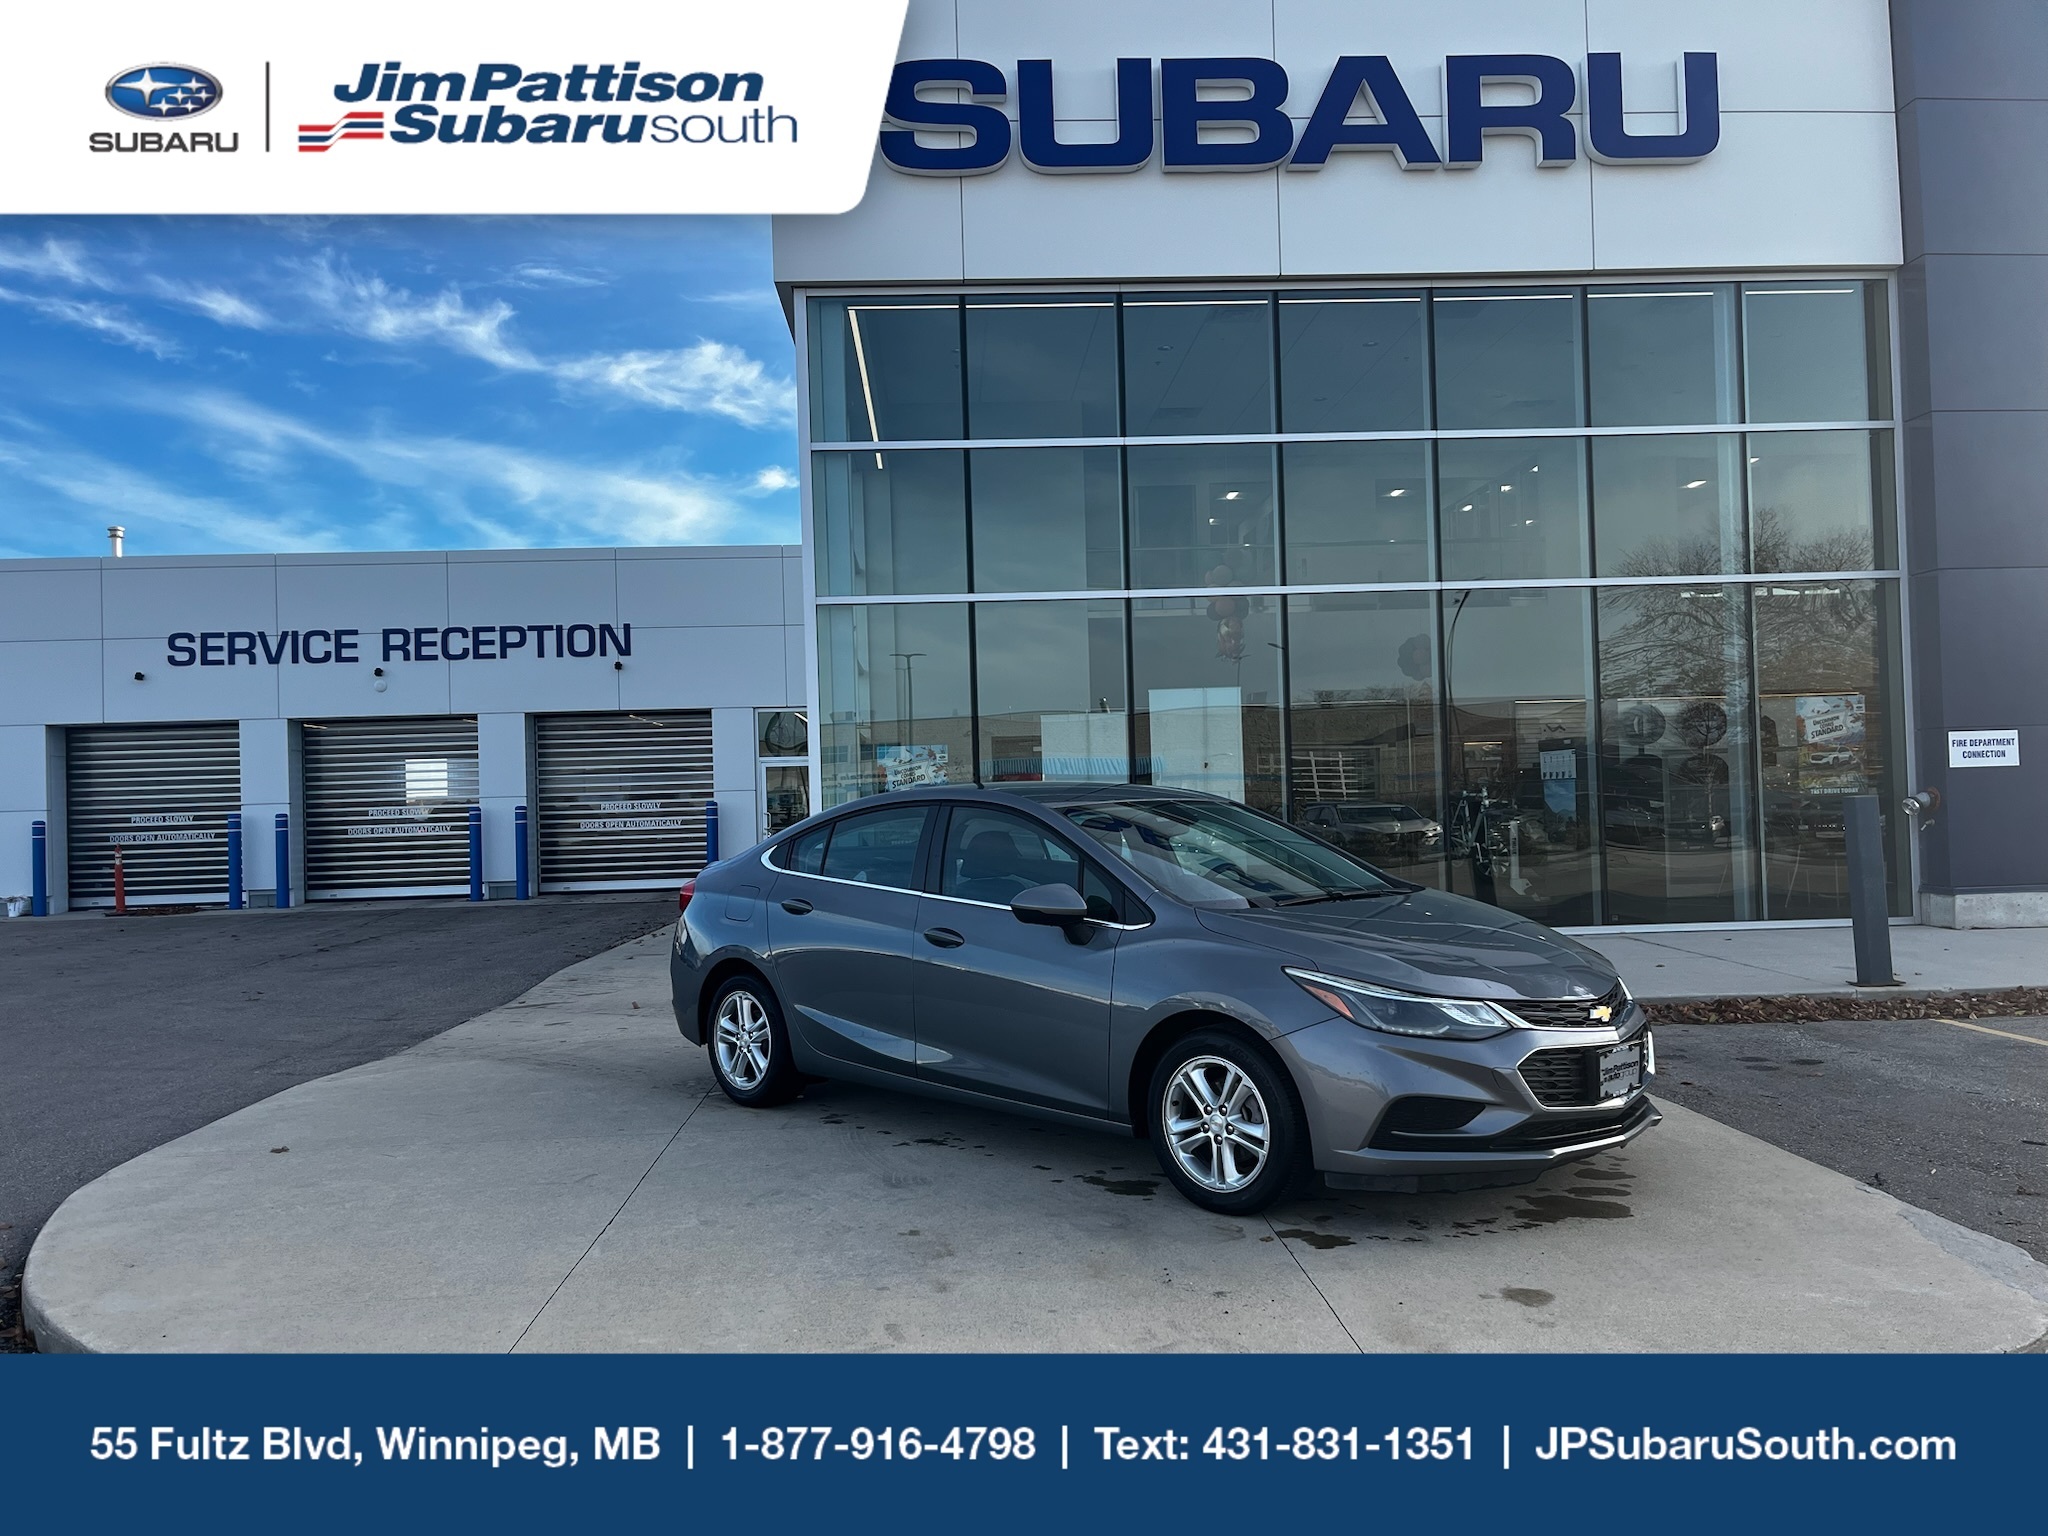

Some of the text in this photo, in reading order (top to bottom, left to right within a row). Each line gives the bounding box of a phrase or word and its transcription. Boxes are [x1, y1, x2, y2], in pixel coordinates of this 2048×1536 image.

[880, 51, 1721, 176] SUBARU
[167, 623, 633, 667] SERVICE RECEPTION
[1811, 724, 1844, 739] STANDARD
[1951, 738, 2015, 748] FIRE DEPARTMENT
[1962, 750, 2006, 759] CONNECTION
[892, 774, 926, 789] STANDARD
[600, 802, 662, 811] PROCEED SLOWLY
[368, 809, 400, 817] PROCEED
[131, 815, 194, 824] PROCEED SLOWLY
[580, 821, 604, 829] DOORS
[625, 819, 683, 828] AUTOMATICALLY
[347, 825, 452, 835] DOORS OPEN AUTOMATICALLY
[109, 832, 216, 842] DOORS OPEN AUTOMATICALLY
[1614, 1060, 1639, 1072] Pattison
